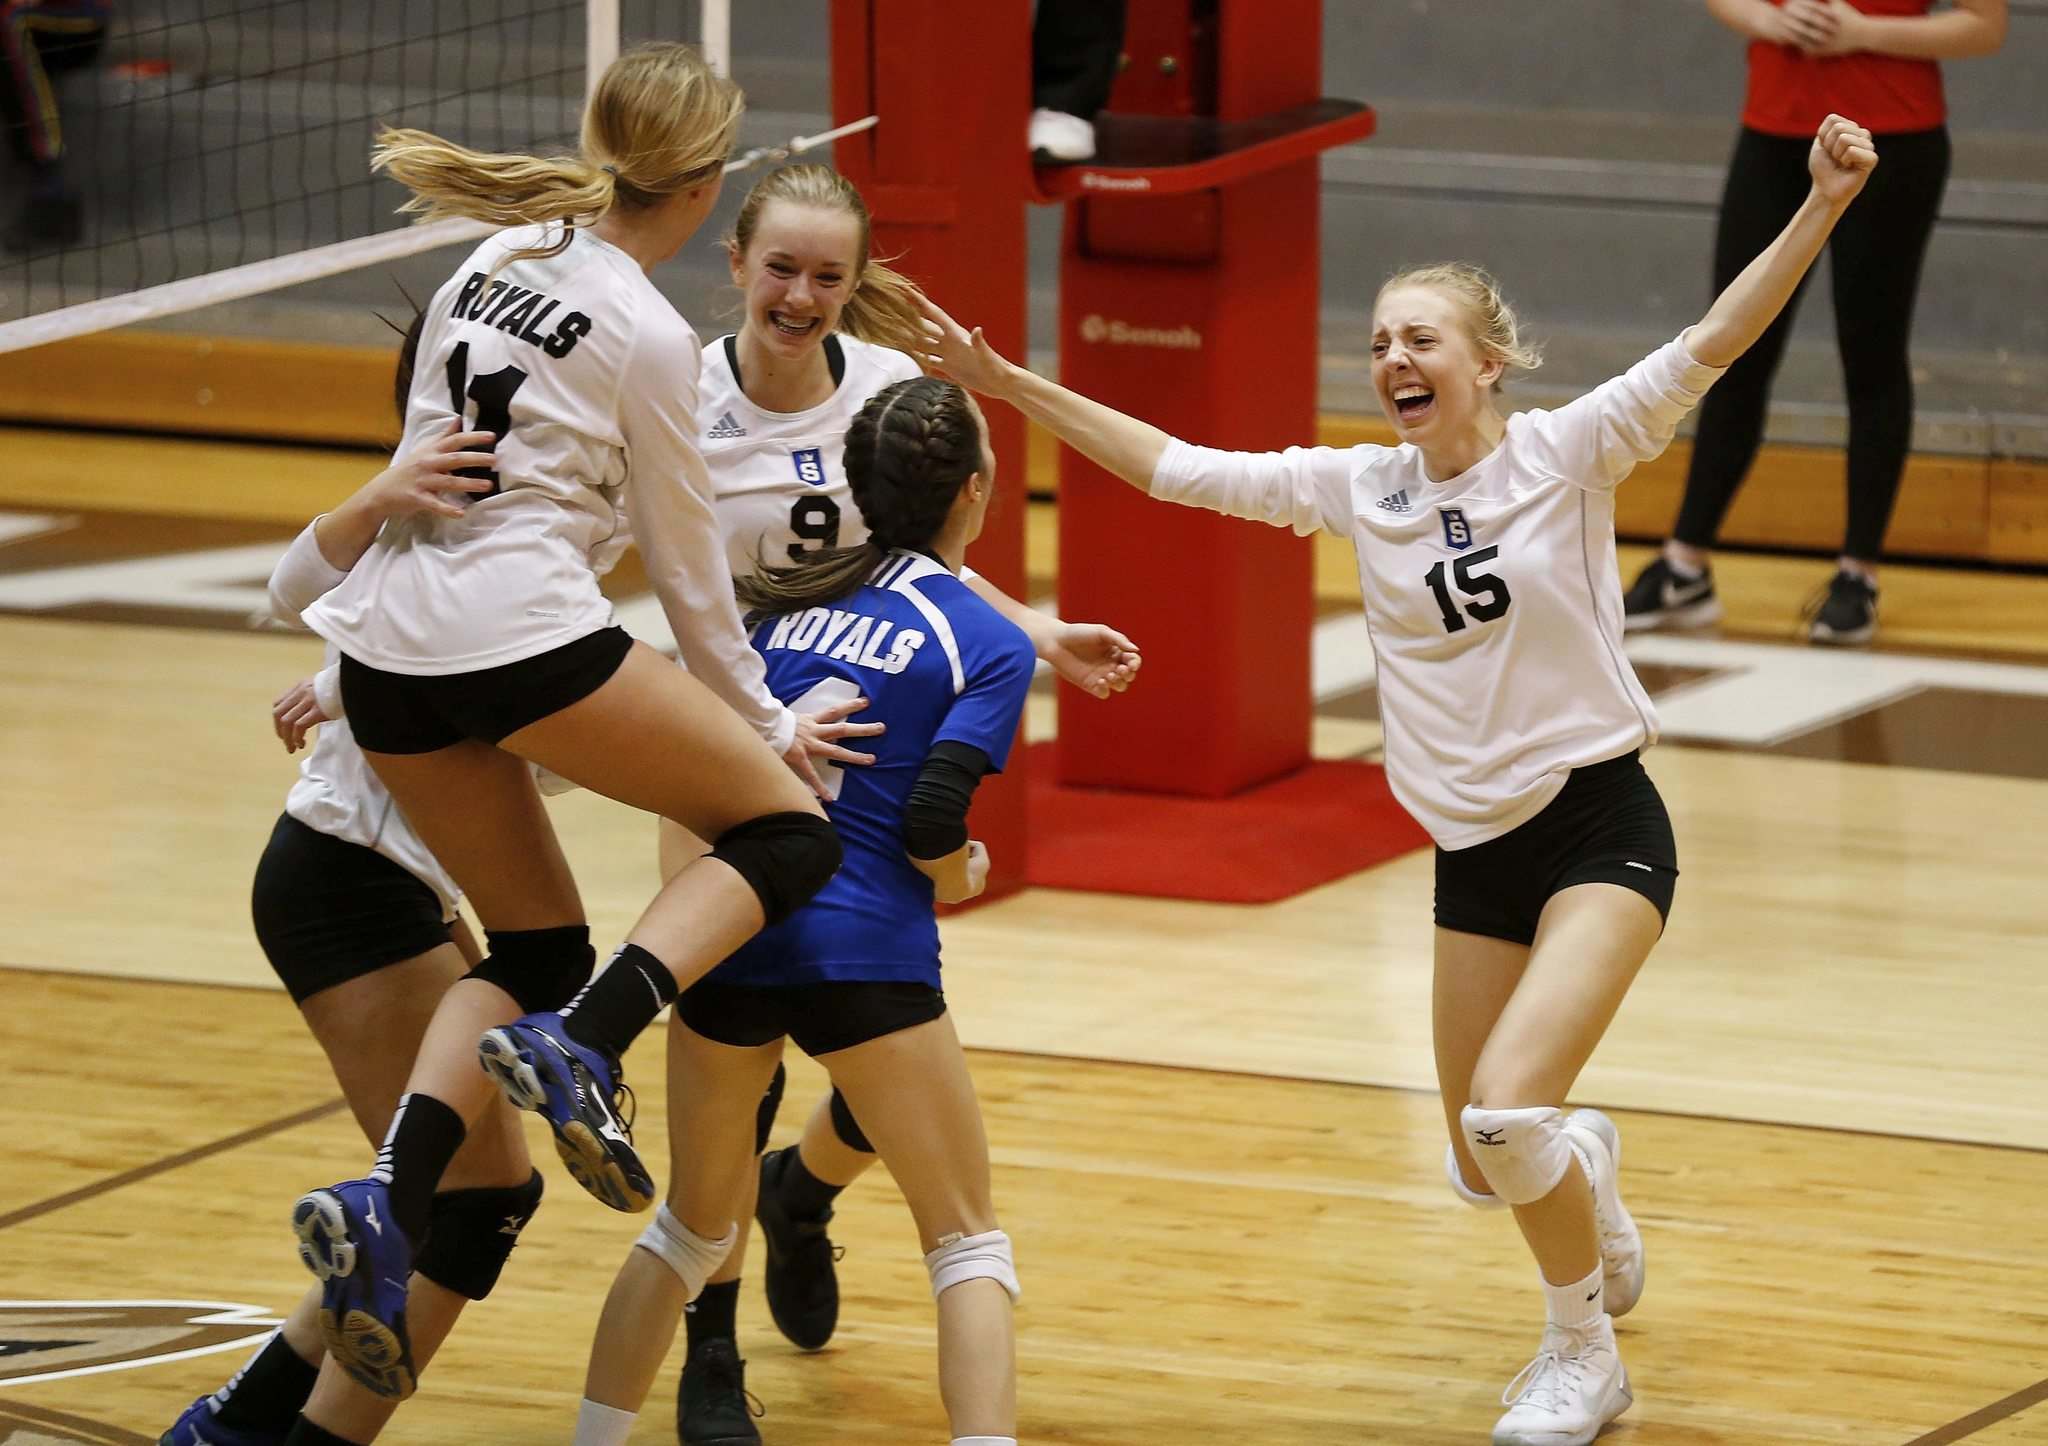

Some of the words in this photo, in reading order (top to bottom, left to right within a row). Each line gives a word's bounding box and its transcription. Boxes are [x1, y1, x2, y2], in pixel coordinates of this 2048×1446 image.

[450, 272, 592, 359] ROYALS
[787, 494, 841, 563] 9
[1424, 545, 1511, 634] 15
[766, 607, 926, 674] ROYALS
